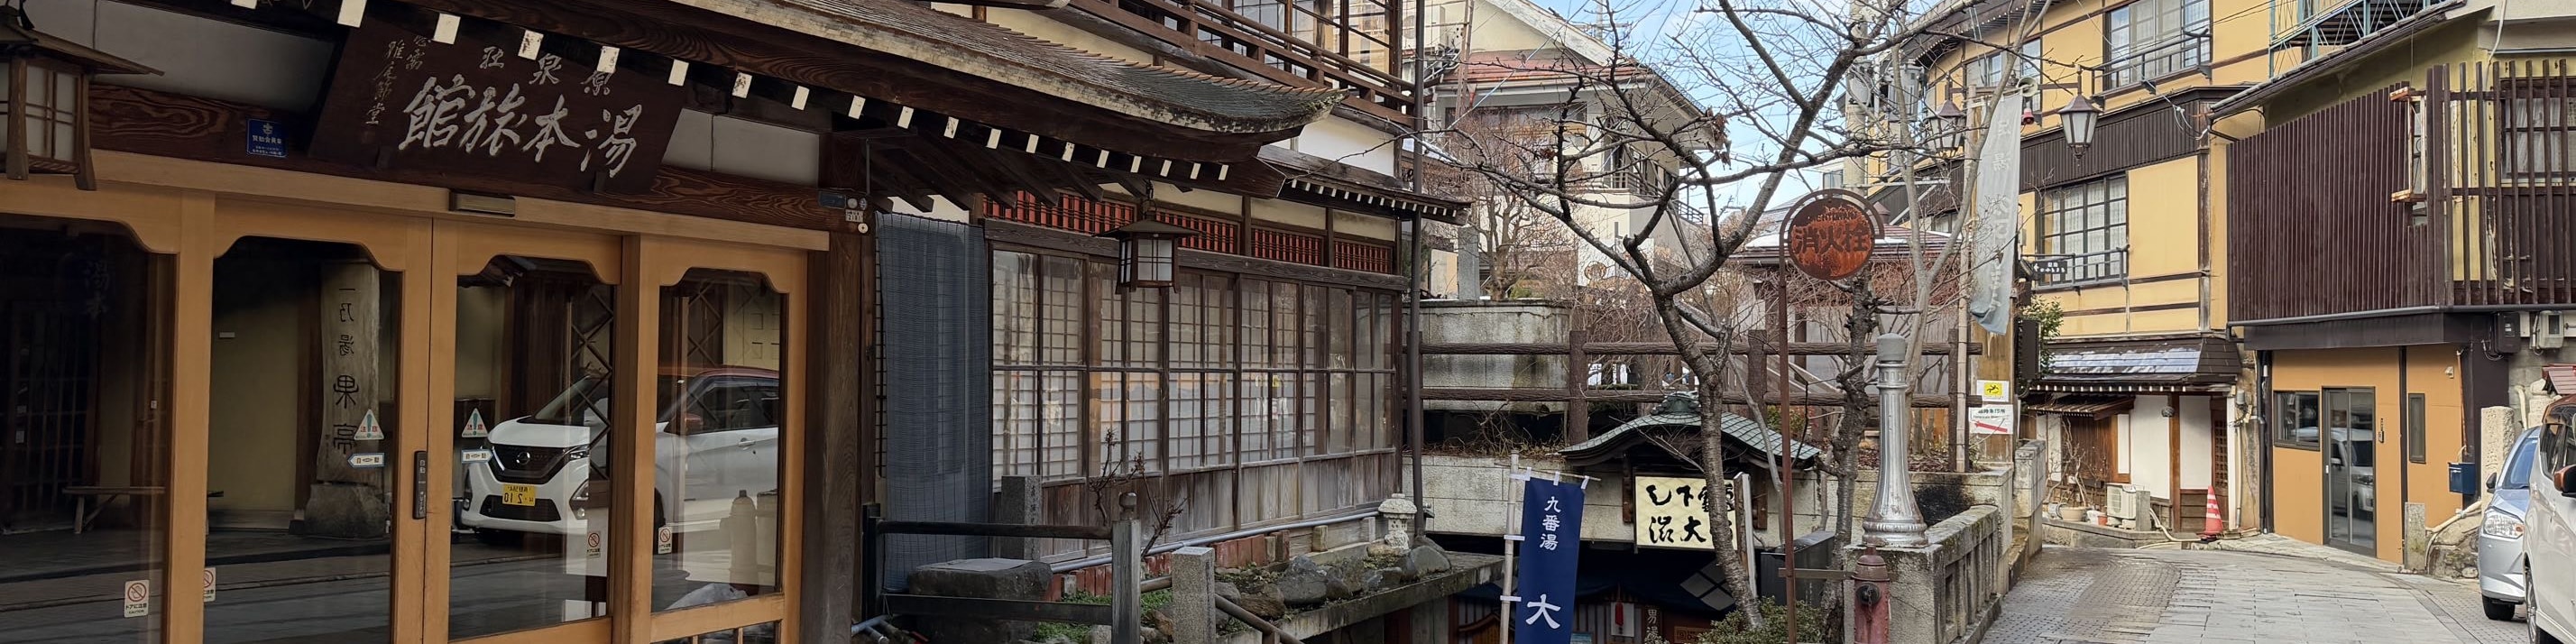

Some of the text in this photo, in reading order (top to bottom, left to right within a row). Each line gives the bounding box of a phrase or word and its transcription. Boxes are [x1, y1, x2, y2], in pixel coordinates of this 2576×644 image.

[399, 73, 642, 178] 湯本旅館
[1793, 224, 1869, 254] 消火栓
[1540, 496, 1561, 551] 九番湯
[1525, 593, 1561, 630] 大
